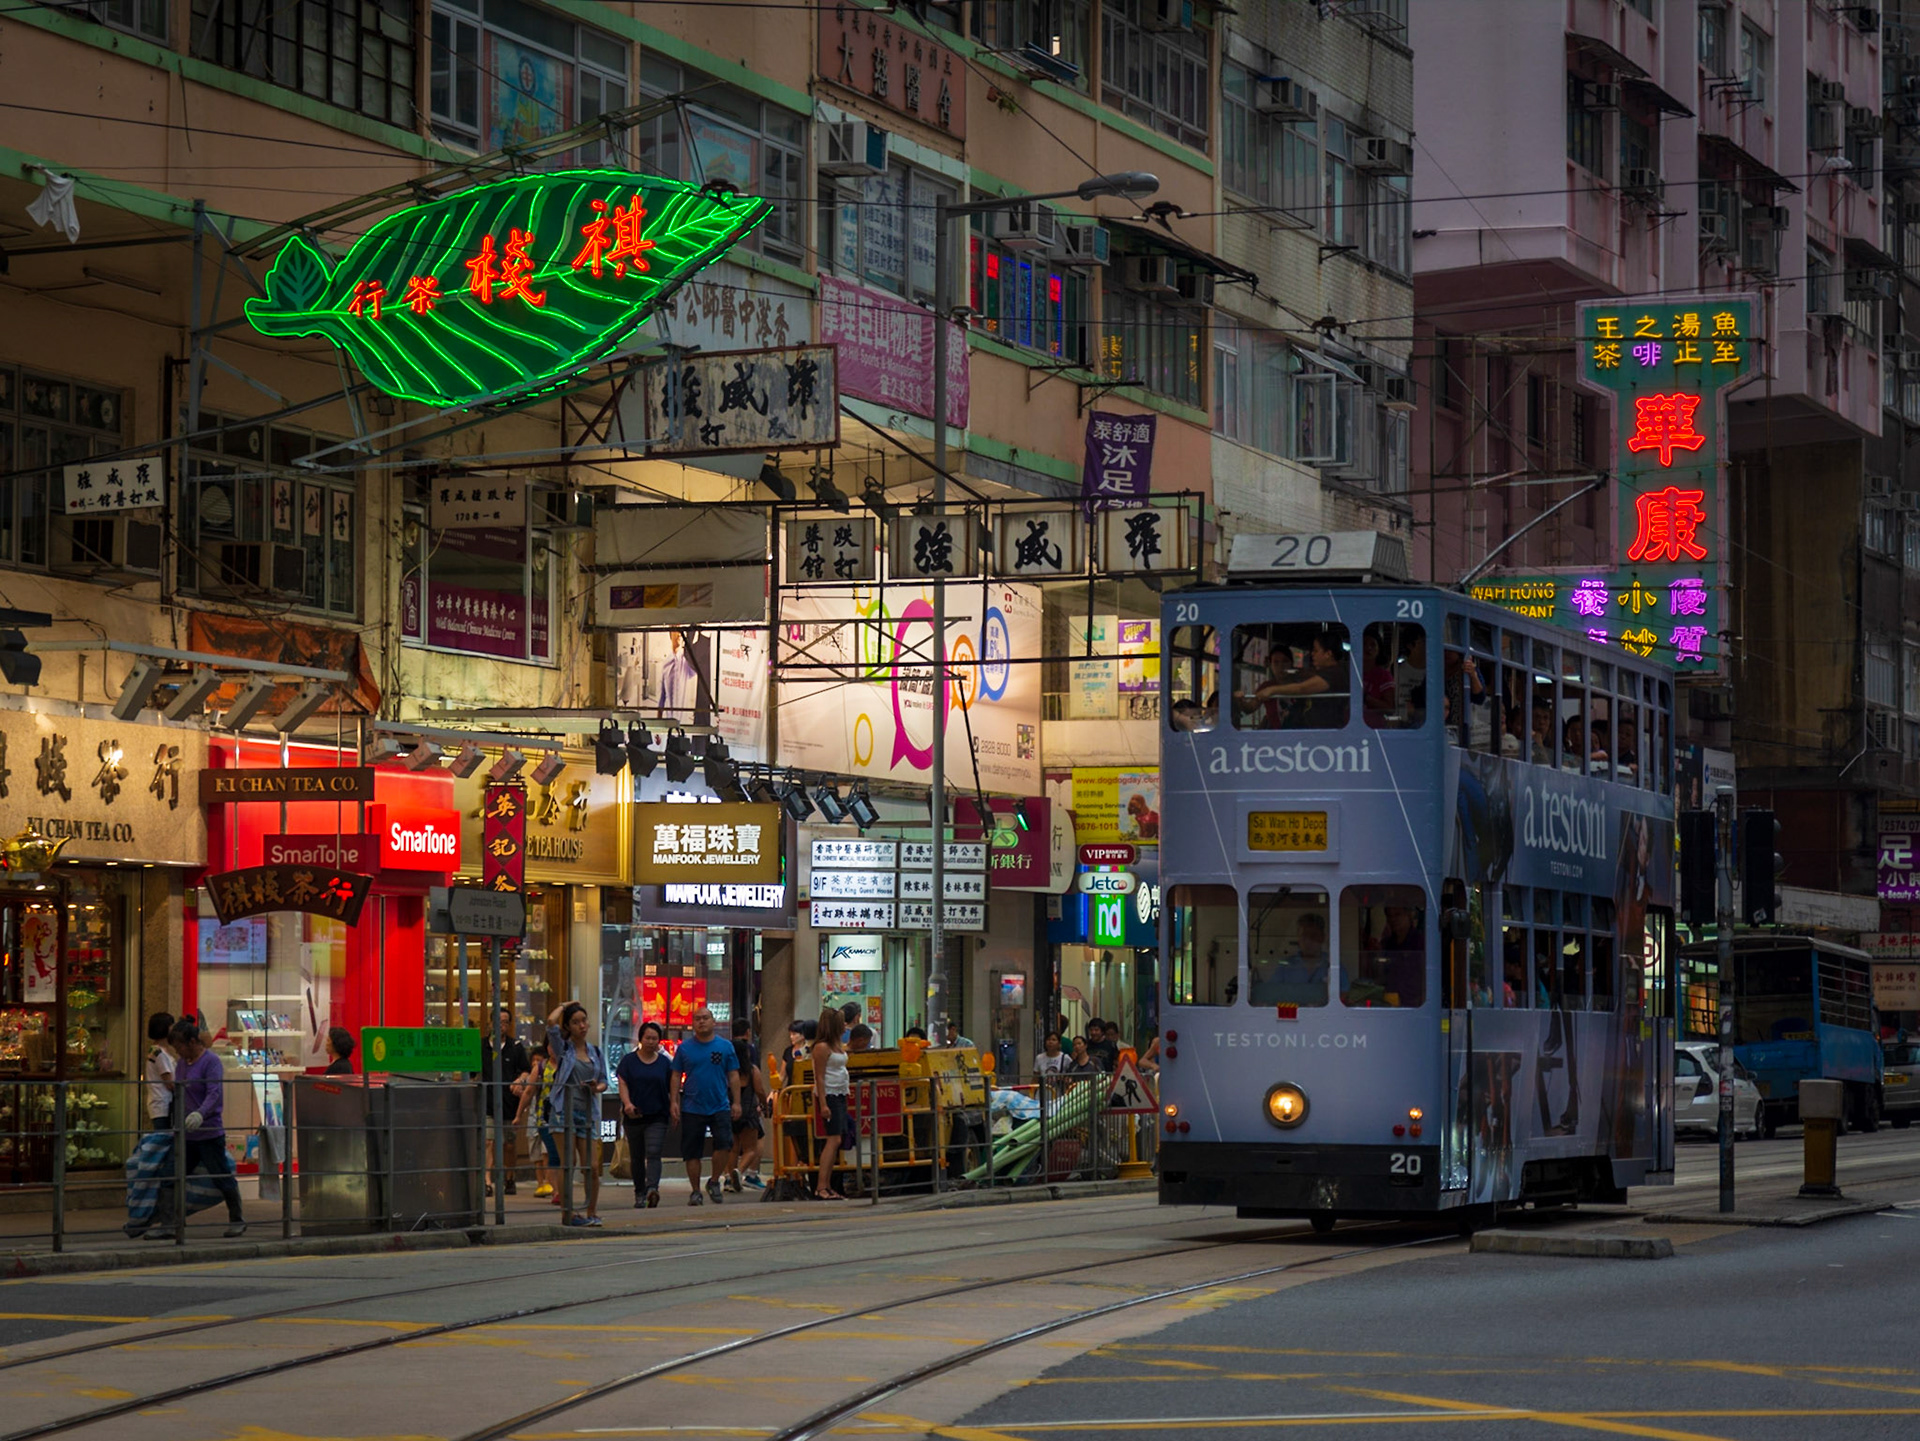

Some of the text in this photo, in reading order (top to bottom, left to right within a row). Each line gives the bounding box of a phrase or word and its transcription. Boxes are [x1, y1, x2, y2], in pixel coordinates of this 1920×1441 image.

[822, 283, 964, 376] 摩理臣山物理療
[1093, 419, 1151, 445] 泰舒適
[1097, 443, 1138, 494] 沐足
[1271, 535, 1331, 567] 20
[1176, 603, 1200, 622] 20
[1396, 599, 1424, 619] 20
[1209, 738, 1371, 775] a.testoni
[214, 776, 359, 793] KI CHAN TEA CO.
[46, 819, 83, 840] CHAN
[86, 821, 110, 841] TEA
[1253, 815, 1267, 828] Sai
[1269, 816, 1287, 829] Wan
[1289, 816, 1300, 829] Ho
[1523, 780, 1607, 860] a.testoni
[535, 836, 555, 857] TEA
[653, 824, 762, 854] 萬福珠寶
[653, 853, 761, 865] MANFOOK JEWELLERY
[905, 845, 982, 857] 香港中師公會
[1086, 849, 1105, 859] VIP
[813, 876, 827, 891] 9/F
[1214, 1032, 1369, 1049] TESTONI.COM
[1389, 1153, 1422, 1177] 20
